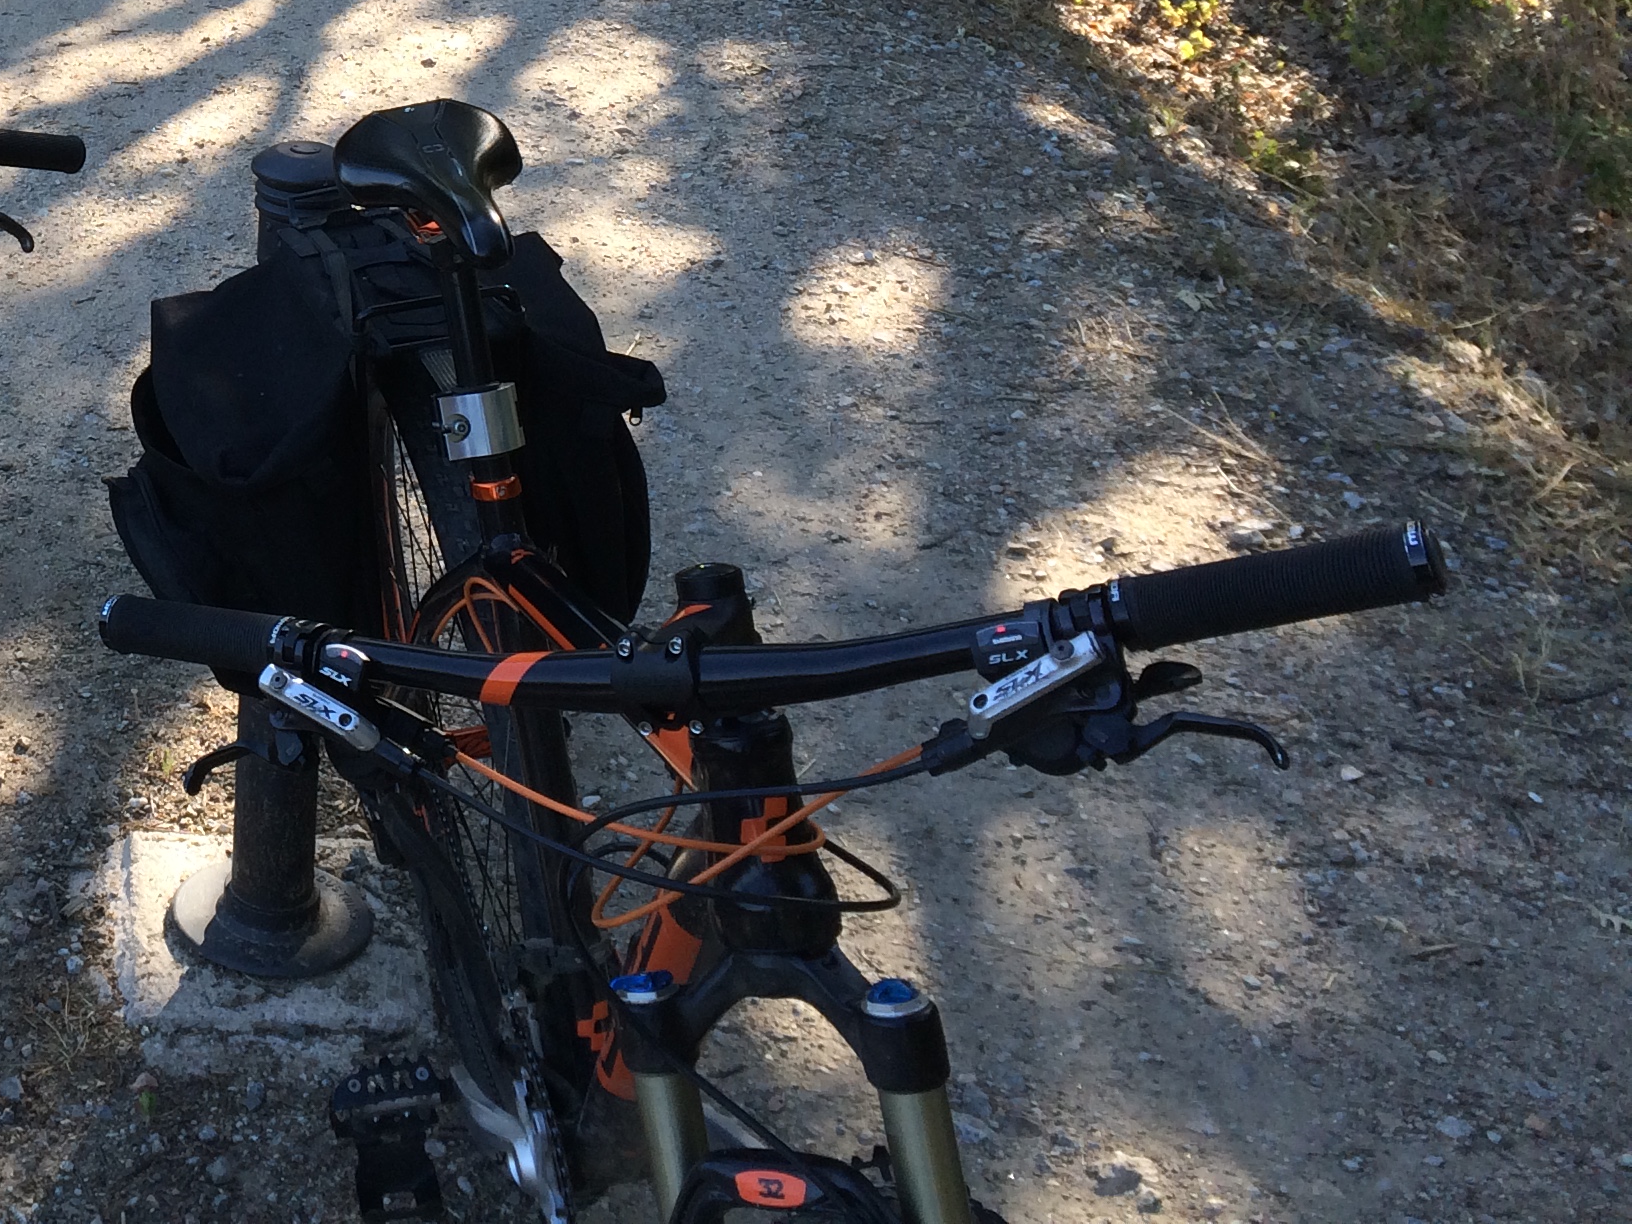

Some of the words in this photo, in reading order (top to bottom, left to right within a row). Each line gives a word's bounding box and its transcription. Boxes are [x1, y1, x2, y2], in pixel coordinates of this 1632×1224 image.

[988, 649, 1029, 665] SLX
[318, 666, 353, 687] SLX
[294, 693, 337, 720] SLX
